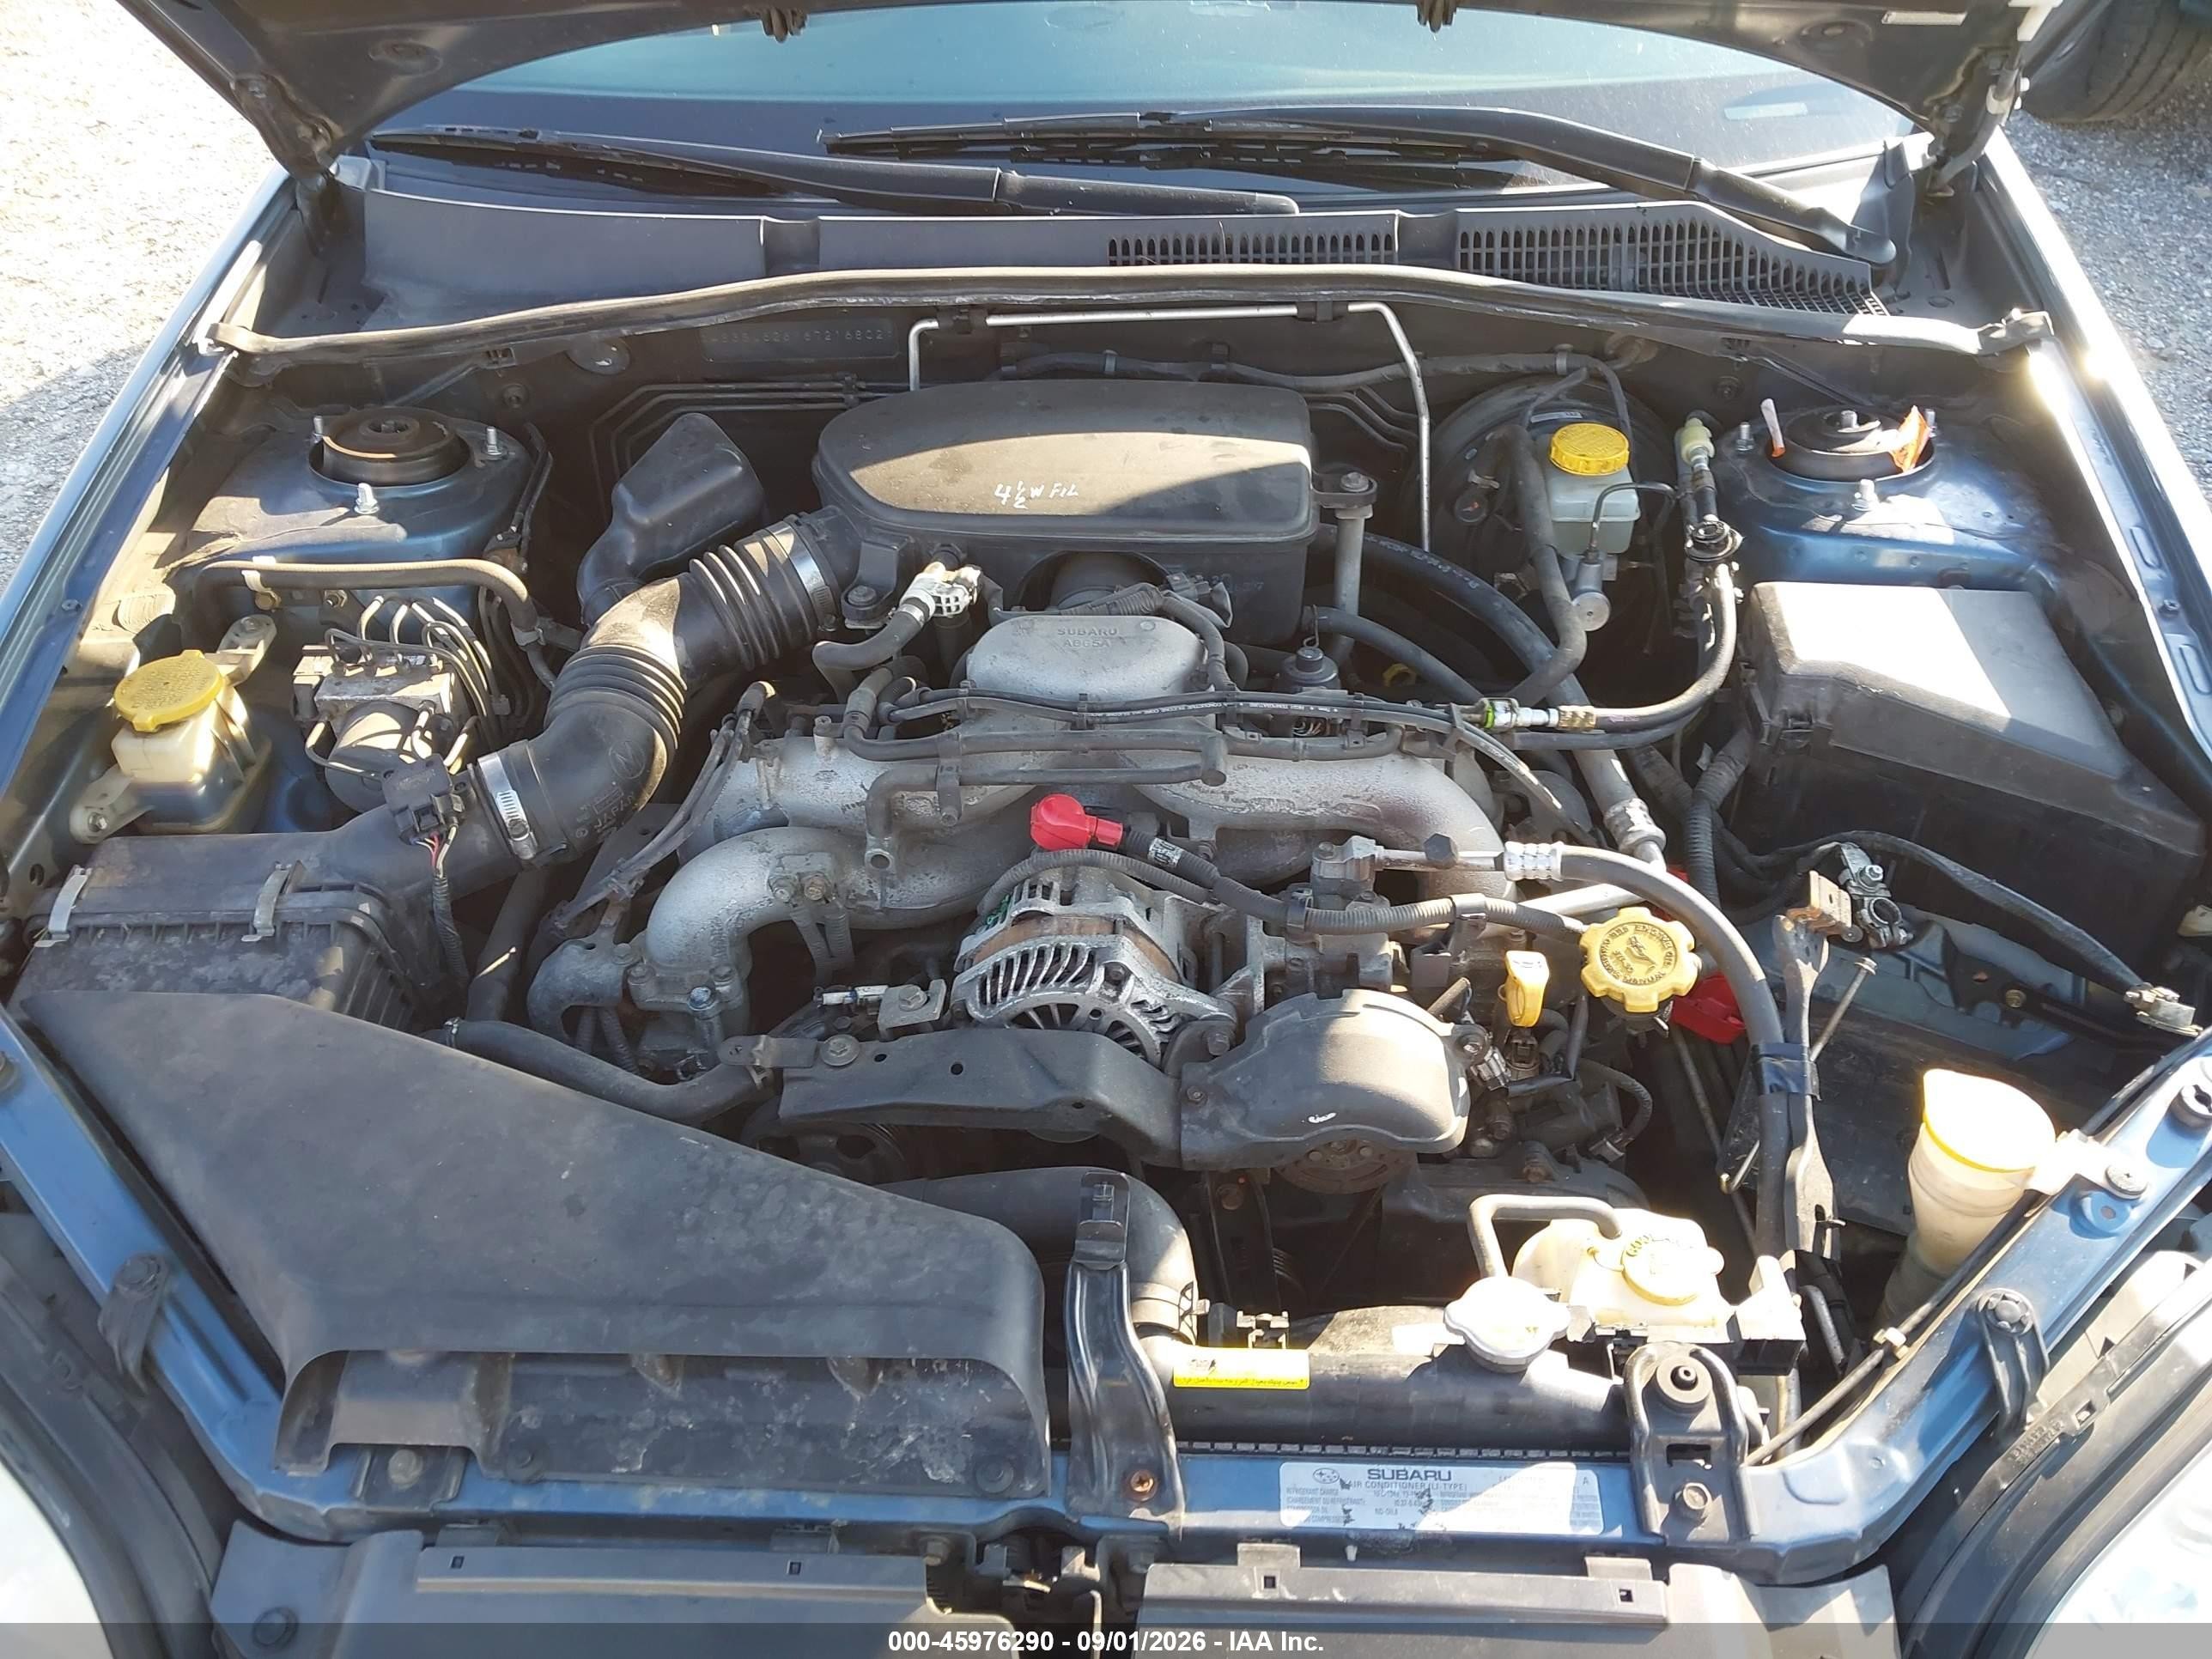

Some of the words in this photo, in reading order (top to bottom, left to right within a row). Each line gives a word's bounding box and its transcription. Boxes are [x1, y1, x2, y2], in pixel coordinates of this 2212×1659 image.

[1057, 628, 1118, 636] SUBARU
[1367, 1468, 1451, 1481] SUBARU
[1365, 1480, 1425, 1491] CONDITIONER
[1582, 1476, 1589, 1486] A
